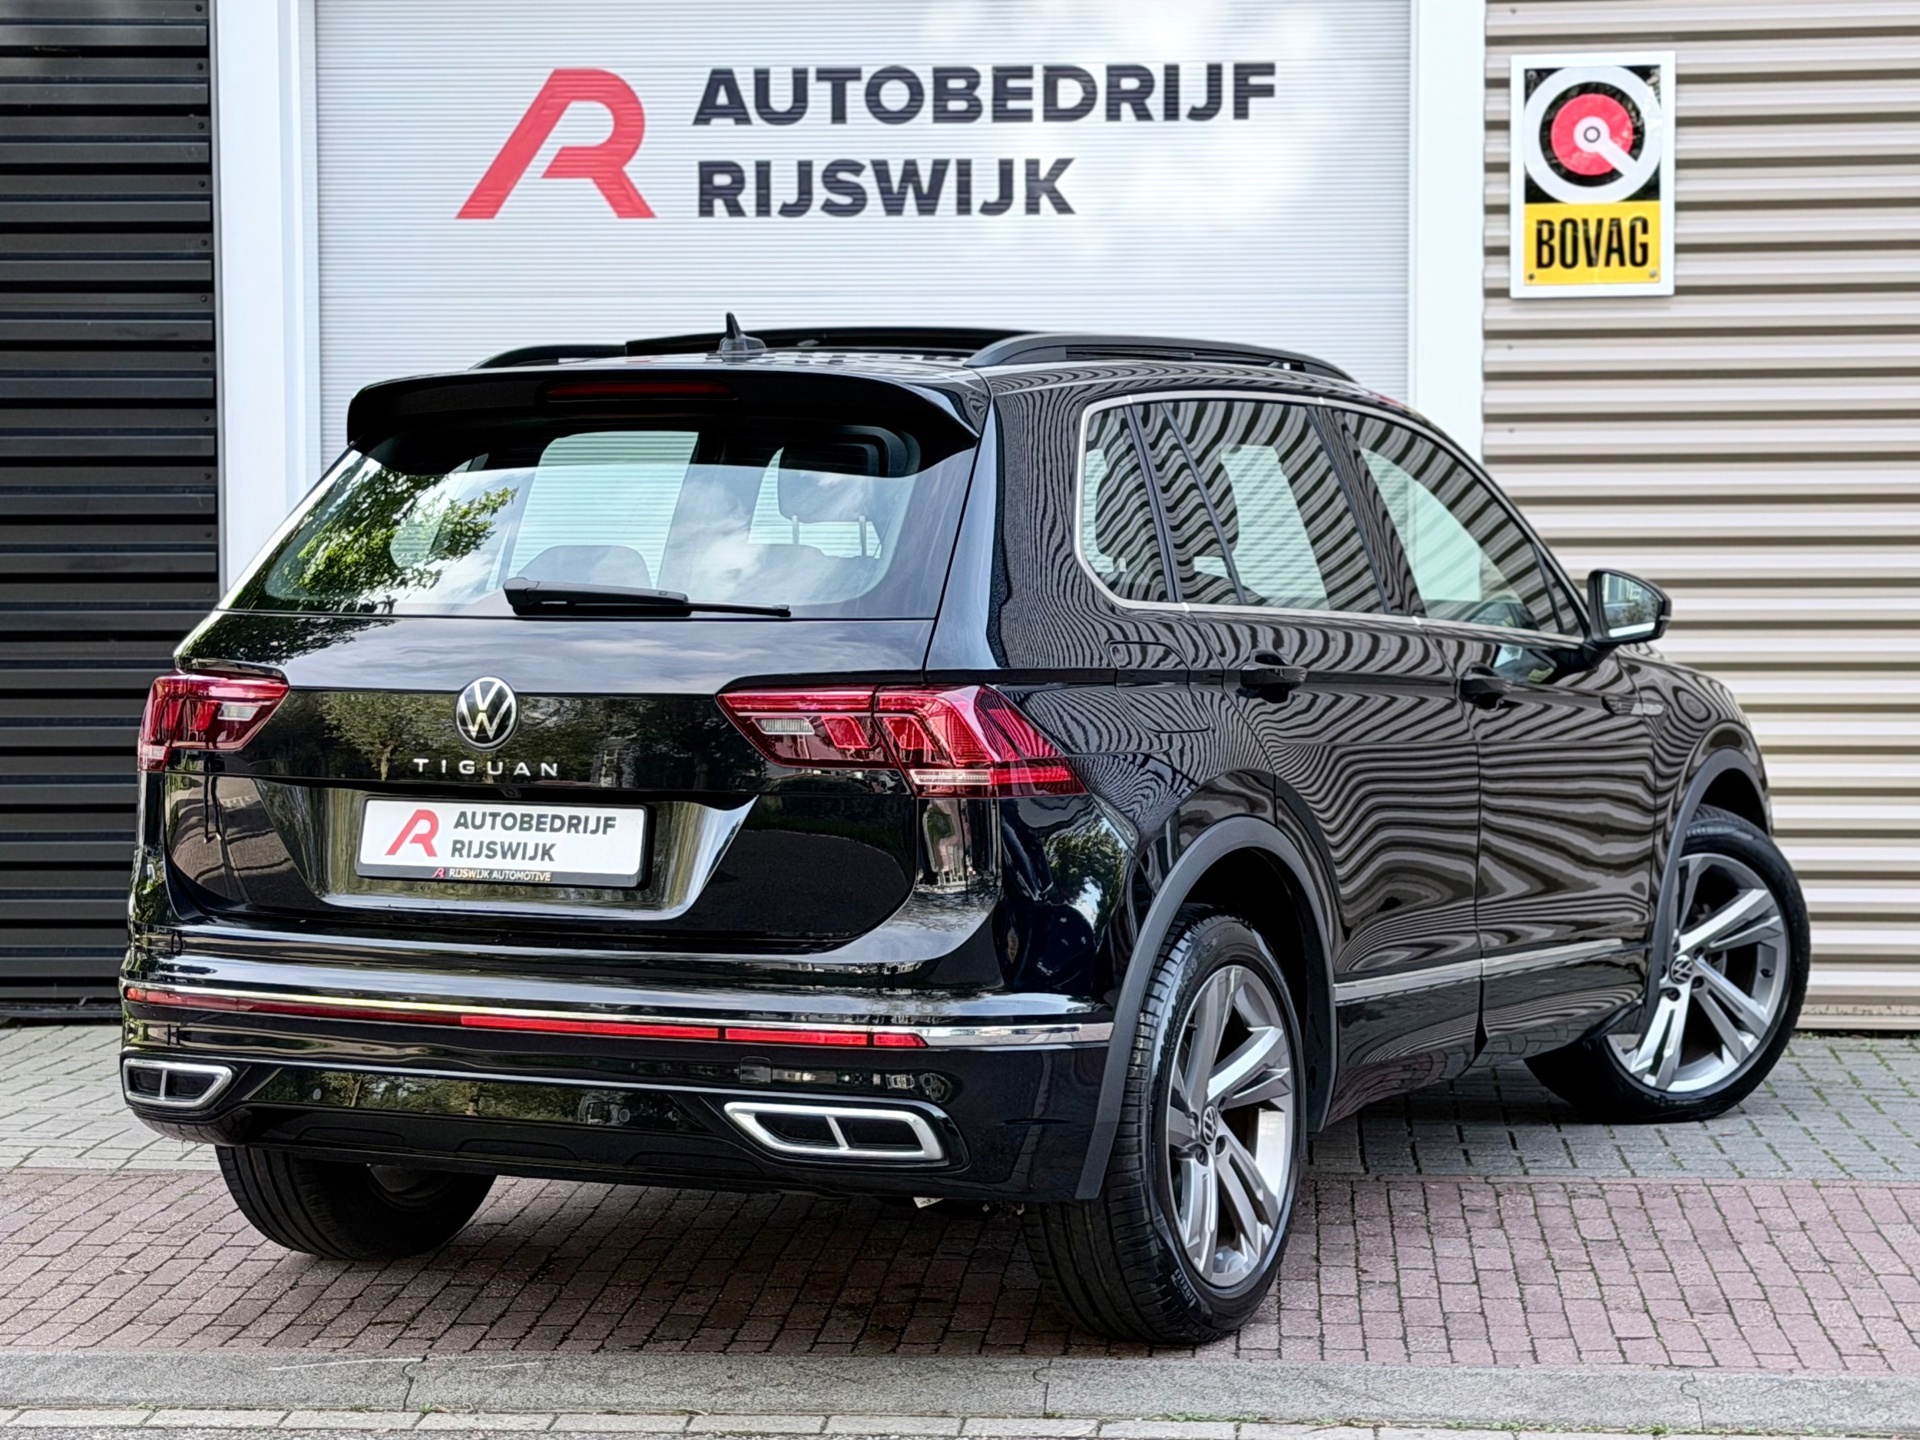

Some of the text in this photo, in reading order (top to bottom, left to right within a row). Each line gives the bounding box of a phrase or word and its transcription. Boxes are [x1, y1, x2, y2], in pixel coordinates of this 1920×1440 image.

[692, 62, 1276, 125] AUTOBEDRIJF
[697, 157, 1076, 218] RIJSWIJK
[1535, 216, 1649, 269] BOVAG
[413, 758, 558, 776] TIGUAN
[453, 811, 617, 835] AUTOBEDRIJF
[450, 840, 556, 861] RIJSWIJK
[449, 868, 490, 879] RIJSWIJK
[492, 870, 552, 881] AUTOMOTIVE
